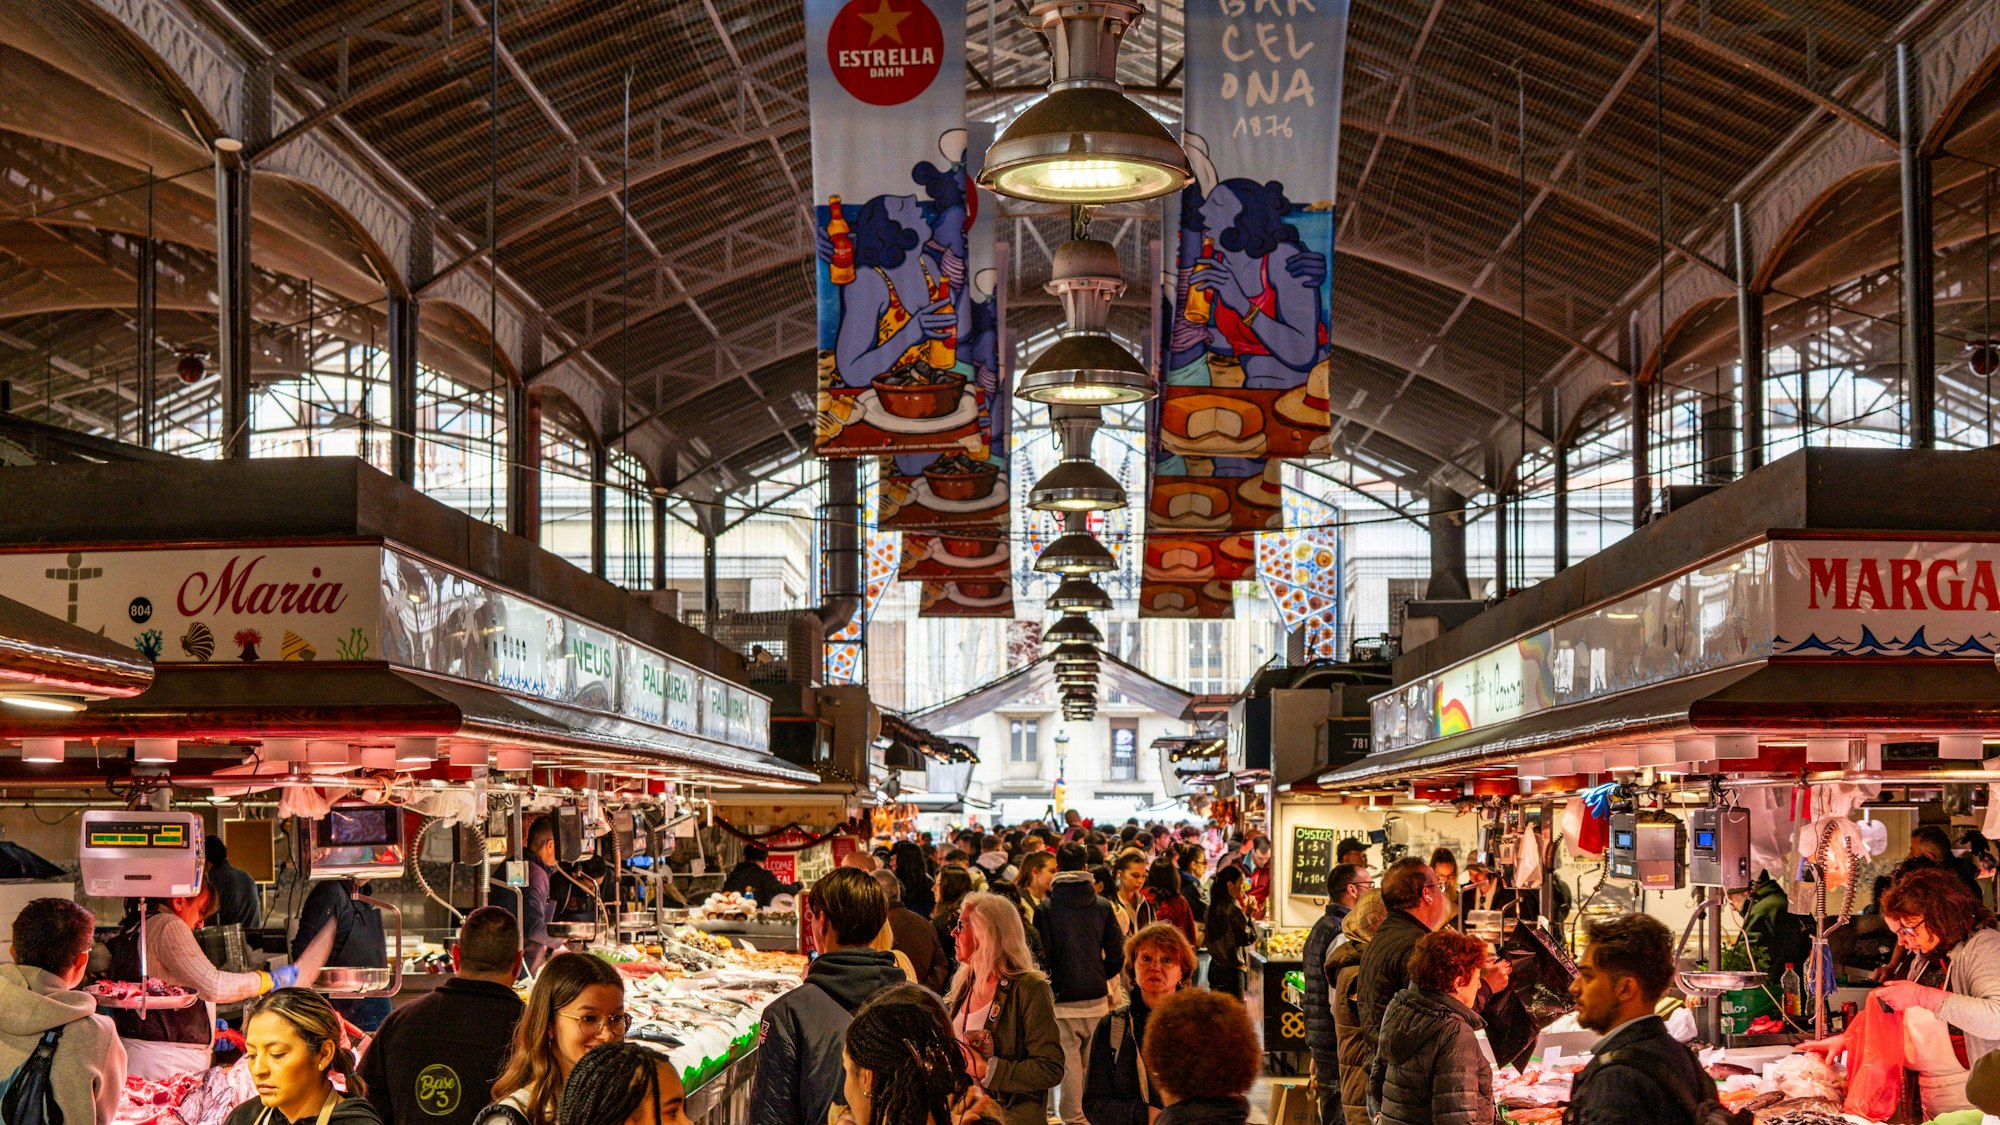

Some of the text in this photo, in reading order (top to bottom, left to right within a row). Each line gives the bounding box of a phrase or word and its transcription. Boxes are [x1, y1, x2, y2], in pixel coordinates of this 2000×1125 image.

[1222, 23, 1315, 62] CEL
[838, 46, 935, 68] ESTRELLA
[869, 66, 905, 78] DAMM
[1221, 68, 1314, 107] ONA
[1232, 115, 1293, 138] 1876
[176, 555, 348, 617] Maria
[1807, 557, 2000, 611] MARGA
[130, 605, 151, 617] 804
[573, 637, 612, 678] NEUS
[643, 663, 688, 705] PALMIRA
[1352, 737, 1368, 749] 781
[1295, 828, 1333, 841] OYSTER
[420, 1074, 455, 1100] Base
[436, 1090, 449, 1108] 3
